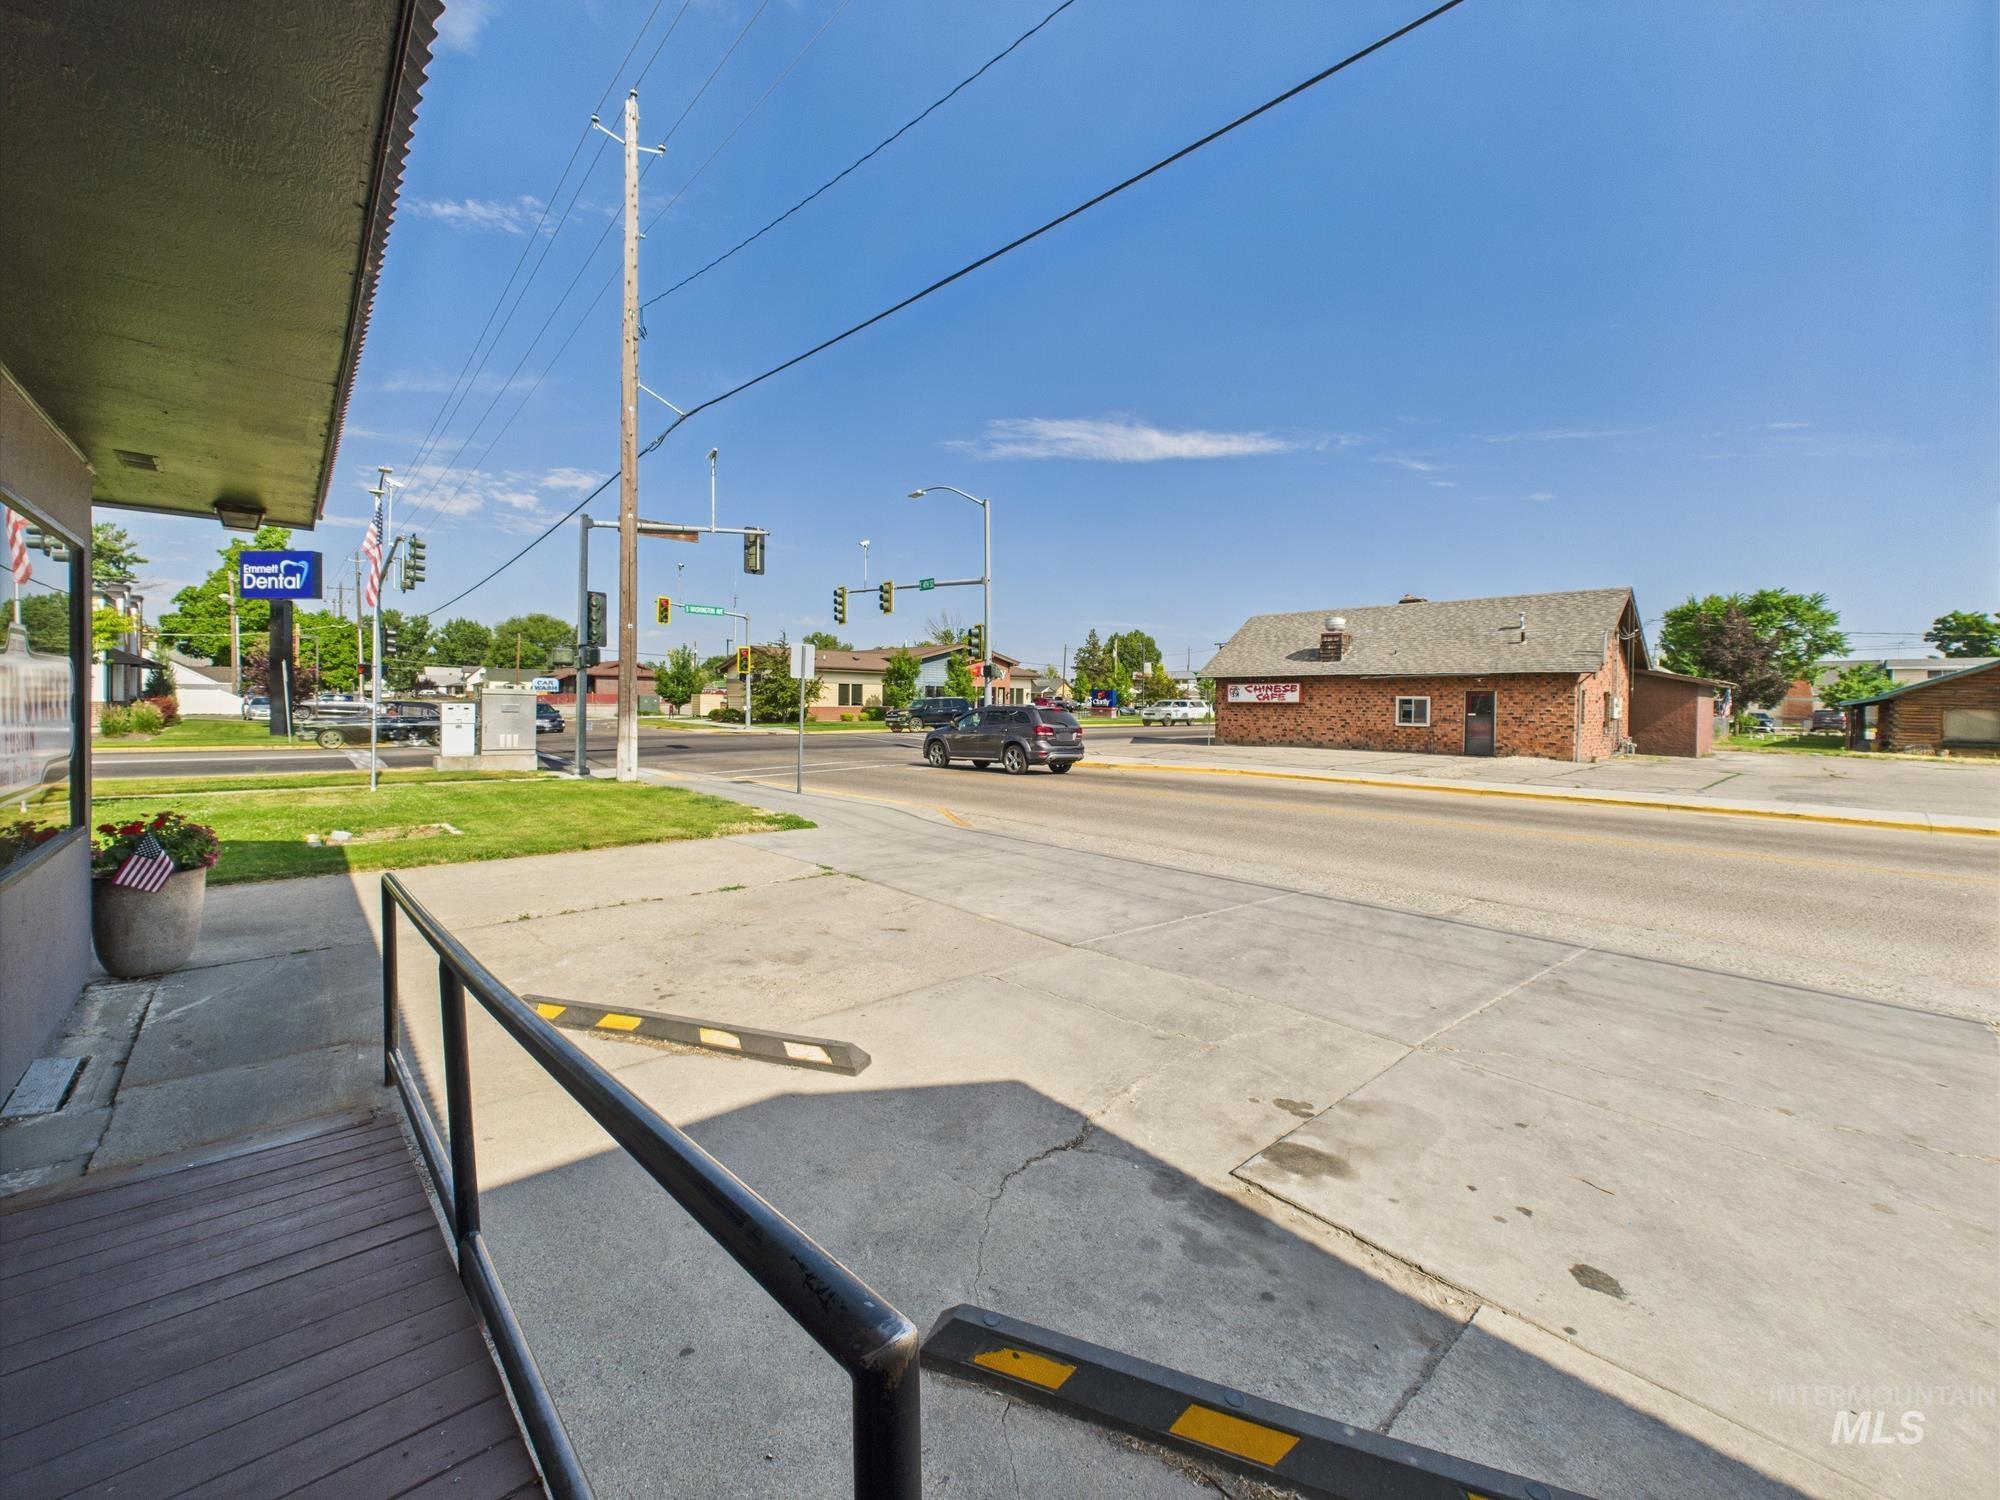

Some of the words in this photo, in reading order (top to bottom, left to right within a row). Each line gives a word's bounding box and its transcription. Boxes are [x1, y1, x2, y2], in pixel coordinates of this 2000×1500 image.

[243, 564, 278, 573] Emmett
[243, 573, 301, 589] Dental
[1244, 684, 1298, 693] CHINESE
[1256, 693, 1286, 701] CAFE
